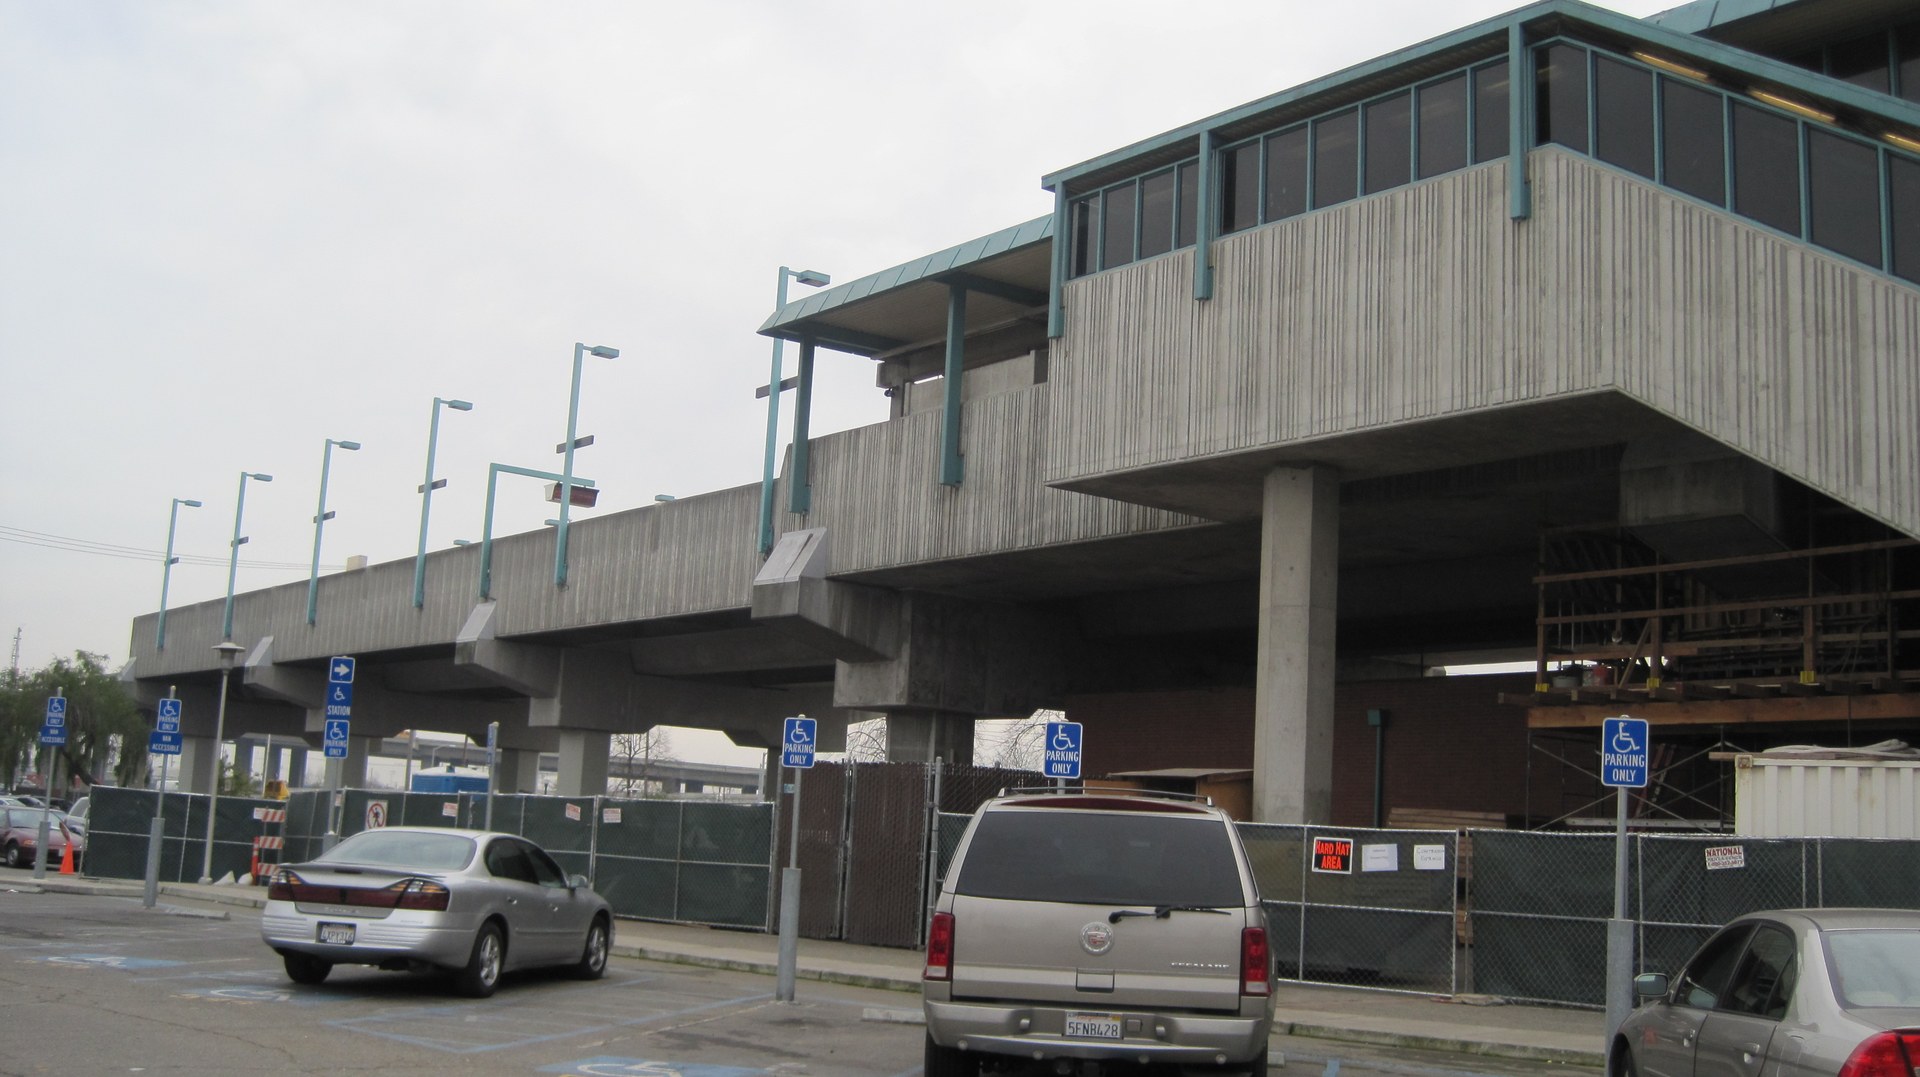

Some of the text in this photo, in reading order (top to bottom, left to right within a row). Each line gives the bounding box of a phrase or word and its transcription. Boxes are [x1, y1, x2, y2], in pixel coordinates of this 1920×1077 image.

[327, 705, 351, 716] STATION
[151, 743, 179, 752] ACCESSIBLE
[785, 743, 814, 754] PARKING
[790, 754, 807, 765] ONLY
[1046, 750, 1079, 762] PARKING
[1604, 753, 1645, 768] PARKING
[1052, 762, 1072, 774] ONLY
[1612, 768, 1637, 783] ONLY
[1315, 840, 1351, 856] HARD HAT
[1706, 847, 1742, 857] NATIONAL
[1321, 855, 1342, 870] AREA
[1068, 1021, 1118, 1037] 5FNB428
